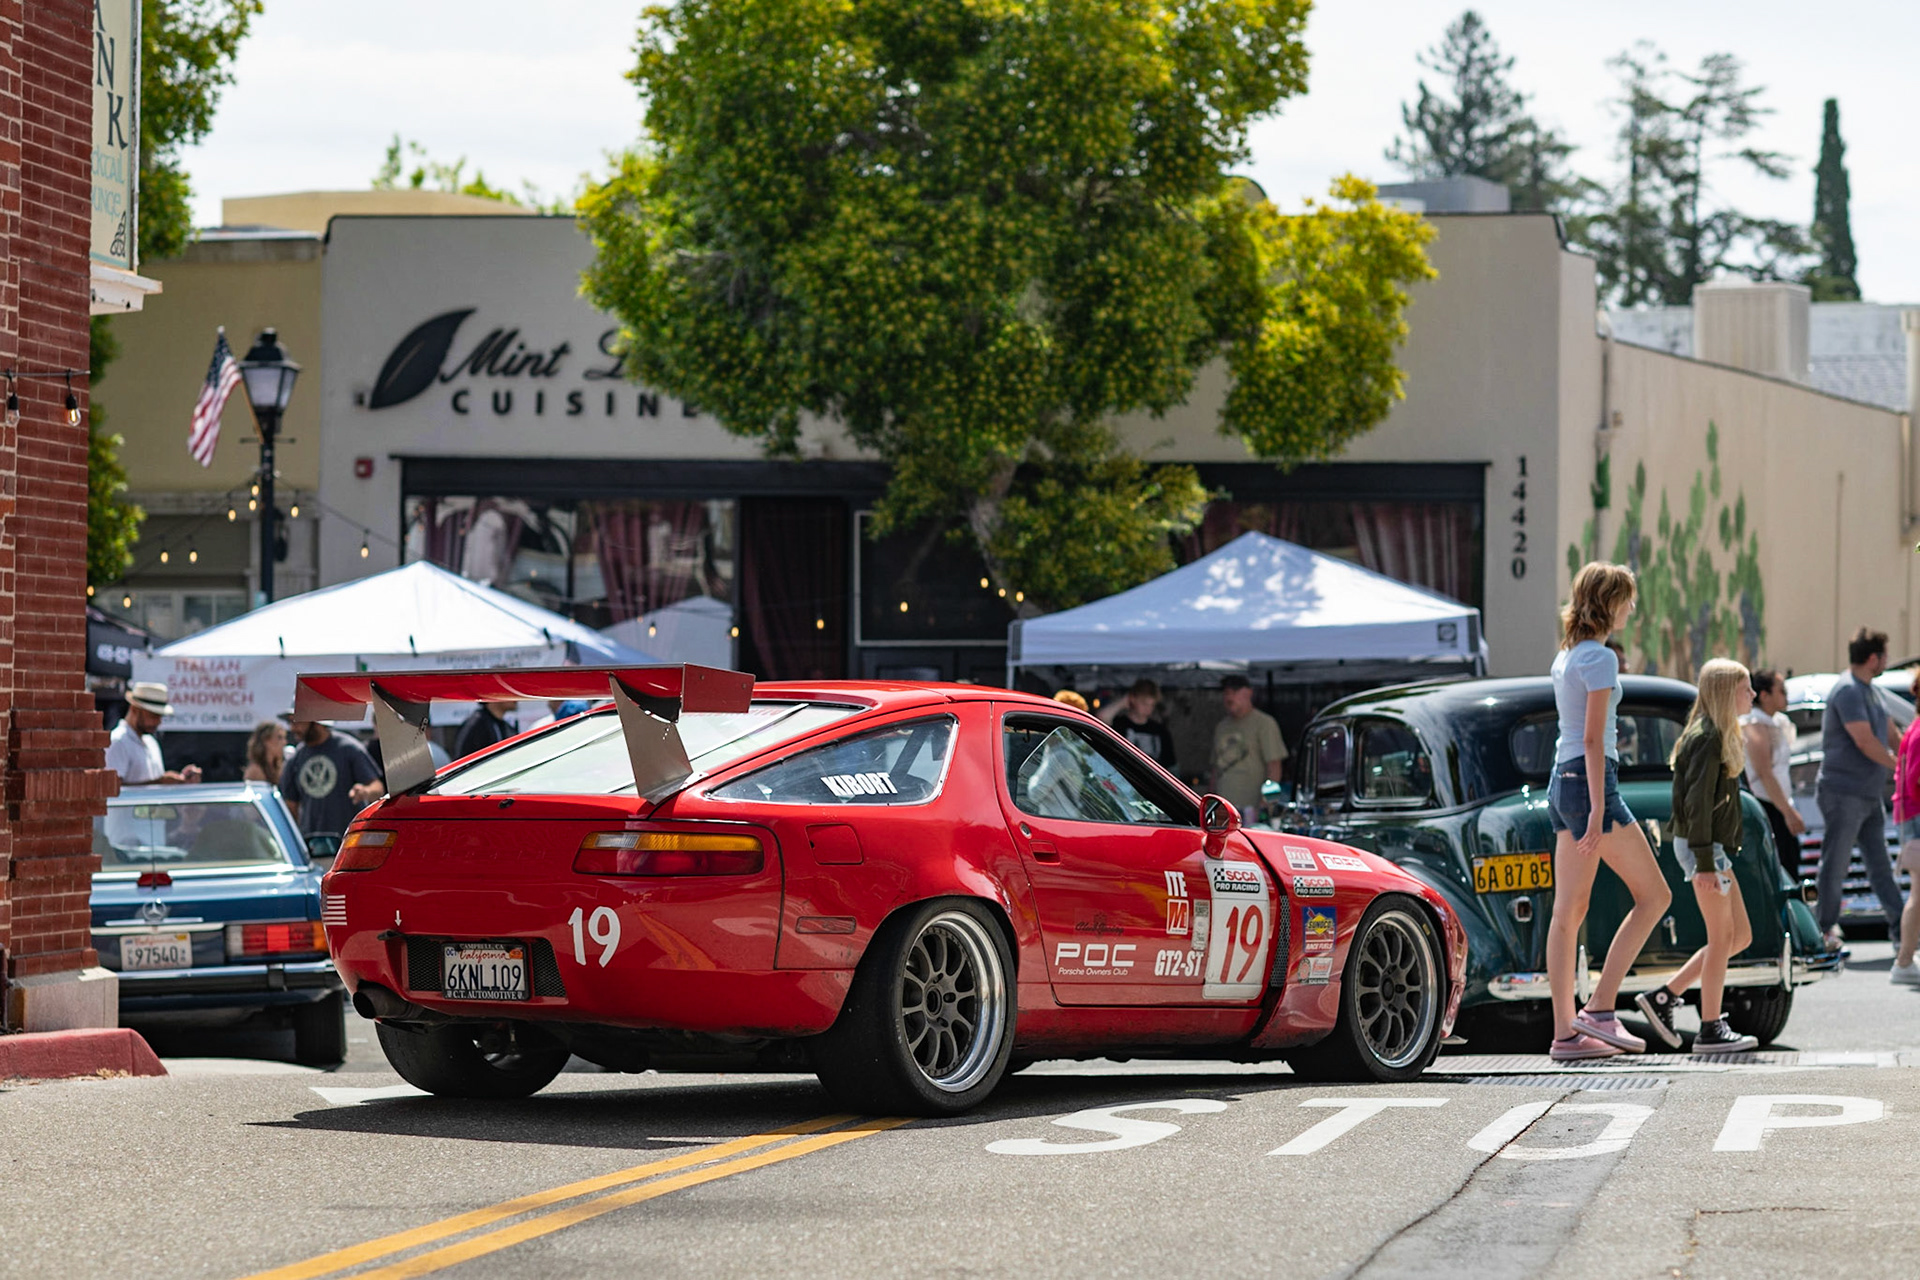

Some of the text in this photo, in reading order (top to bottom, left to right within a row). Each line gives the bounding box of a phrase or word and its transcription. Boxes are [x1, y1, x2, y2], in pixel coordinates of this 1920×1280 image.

[438, 328, 571, 384] Mint
[1511, 455, 1530, 580] 14420
[175, 659, 241, 673] ITALIAN
[167, 674, 248, 690] SAUSAGE
[167, 690, 255, 706] ANDWICH
[820, 772, 898, 797] KIBORT
[1164, 871, 1188, 897] ITE
[1215, 882, 1259, 892] PRO RACING
[1225, 870, 1259, 882] SCCA
[1304, 878, 1332, 887] SCCA
[1477, 861, 1550, 889] 6A 87 85
[567, 906, 621, 968] 19
[1219, 904, 1264, 984] 19
[460, 949, 511, 964] California
[1054, 942, 1137, 967] POC
[1154, 949, 1204, 977] GT2-ST
[447, 964, 522, 991] 6KNL109
[1058, 967, 1128, 976] Porsche Owners Club
[453, 990, 517, 1000] C.T. AUTOMOTIVE
[985, 1094, 1888, 1160] STOP
